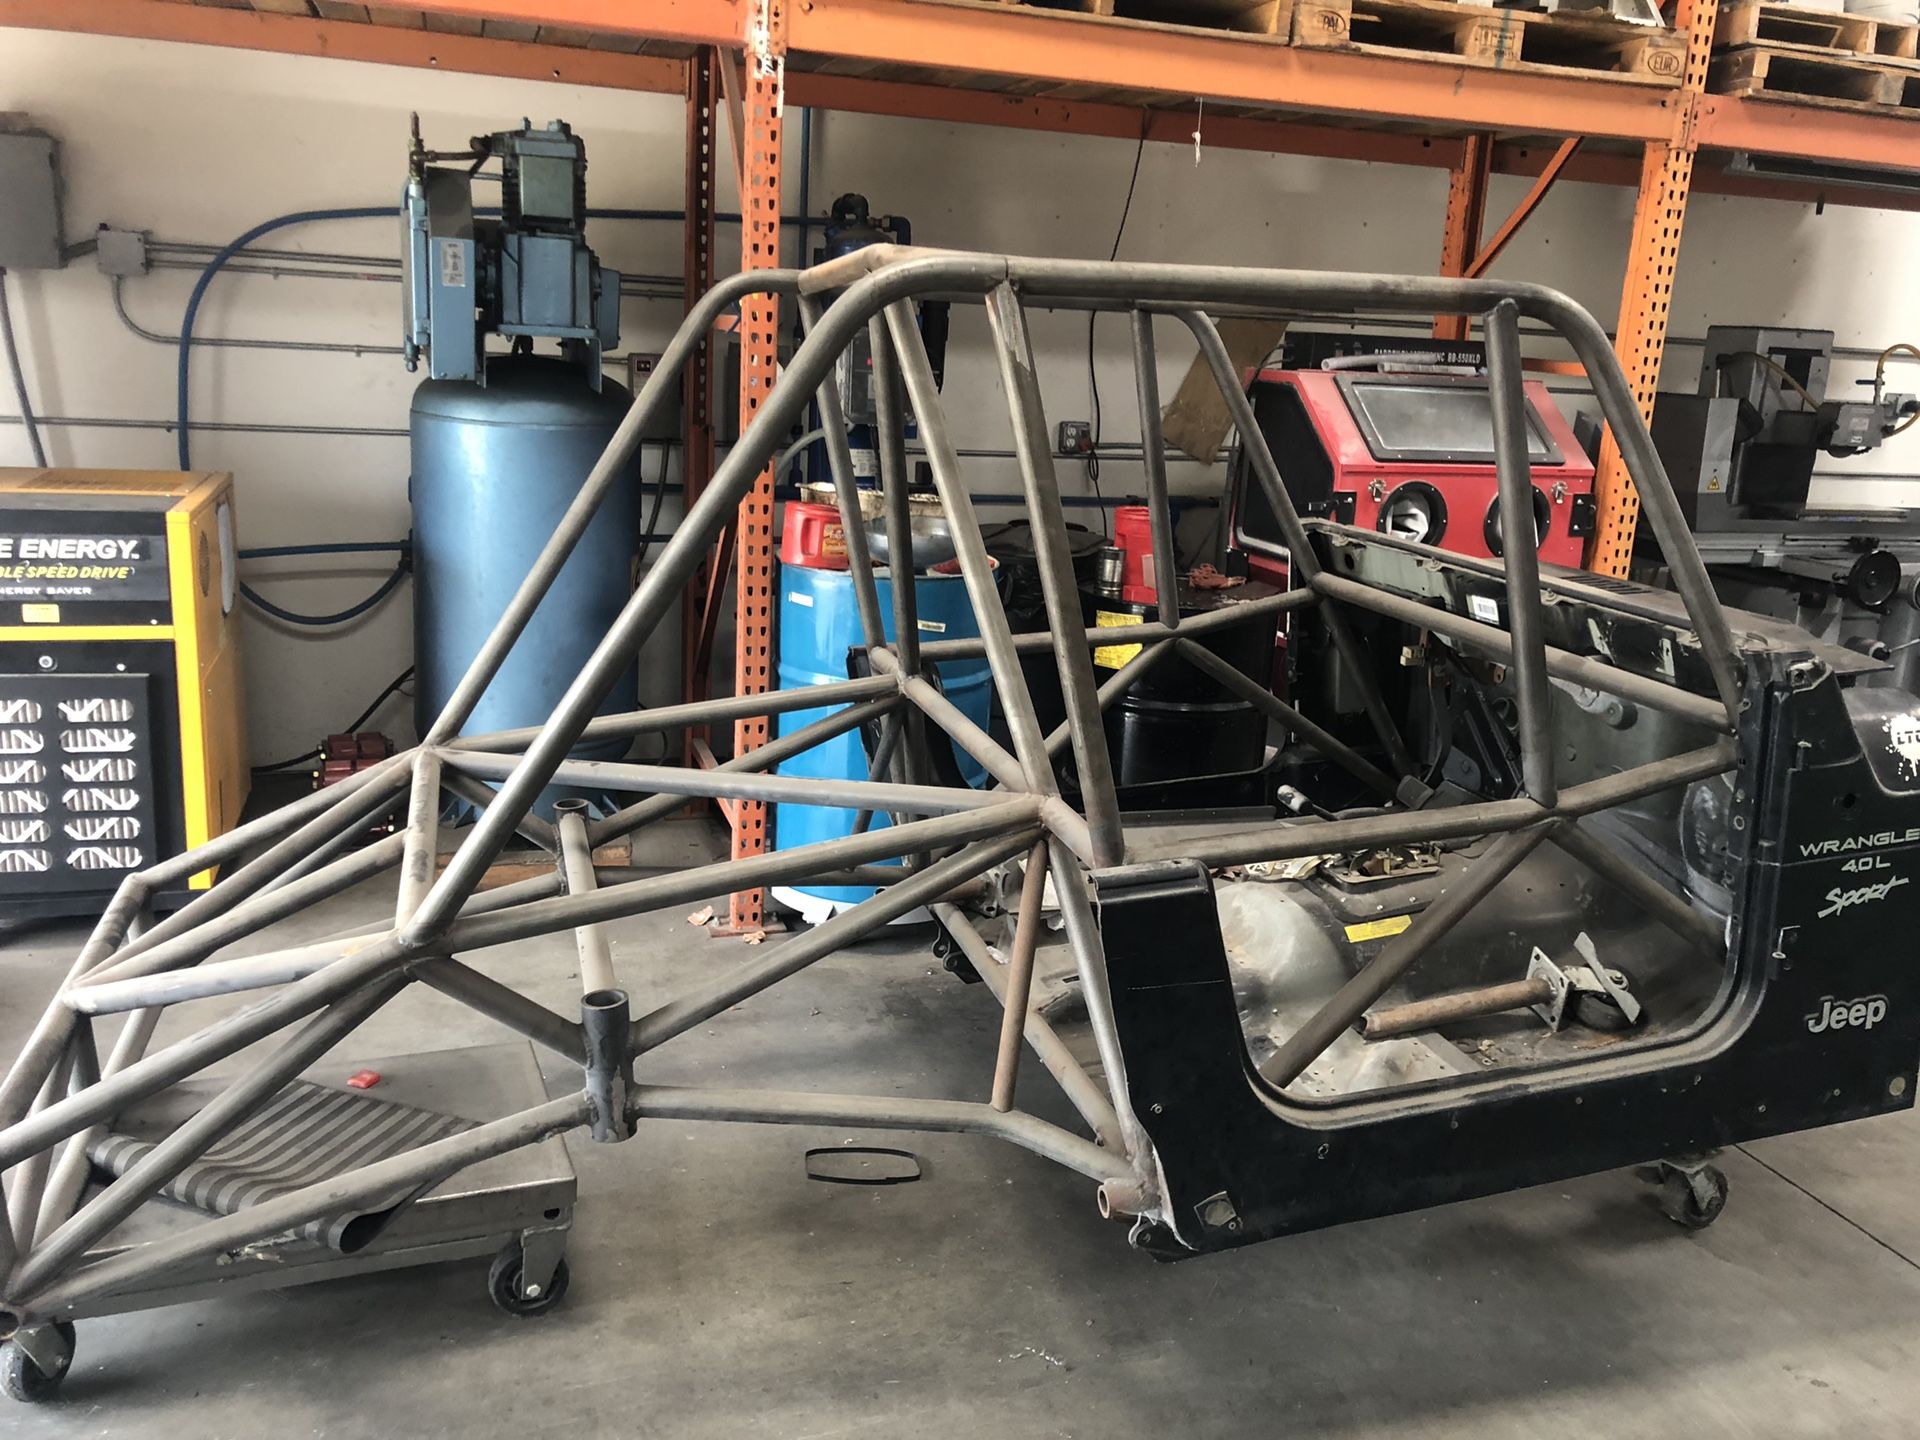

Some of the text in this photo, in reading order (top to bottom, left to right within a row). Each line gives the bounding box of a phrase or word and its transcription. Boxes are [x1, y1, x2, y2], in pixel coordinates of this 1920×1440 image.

[1653, 55, 1675, 71] EUR
[26, 566, 78, 579] SPEED
[79, 566, 130, 579] DRIVE
[46, 587, 92, 595] SAVER
[1800, 828, 1920, 857] WRANGLE
[1807, 1000, 1887, 1033] Jeep
